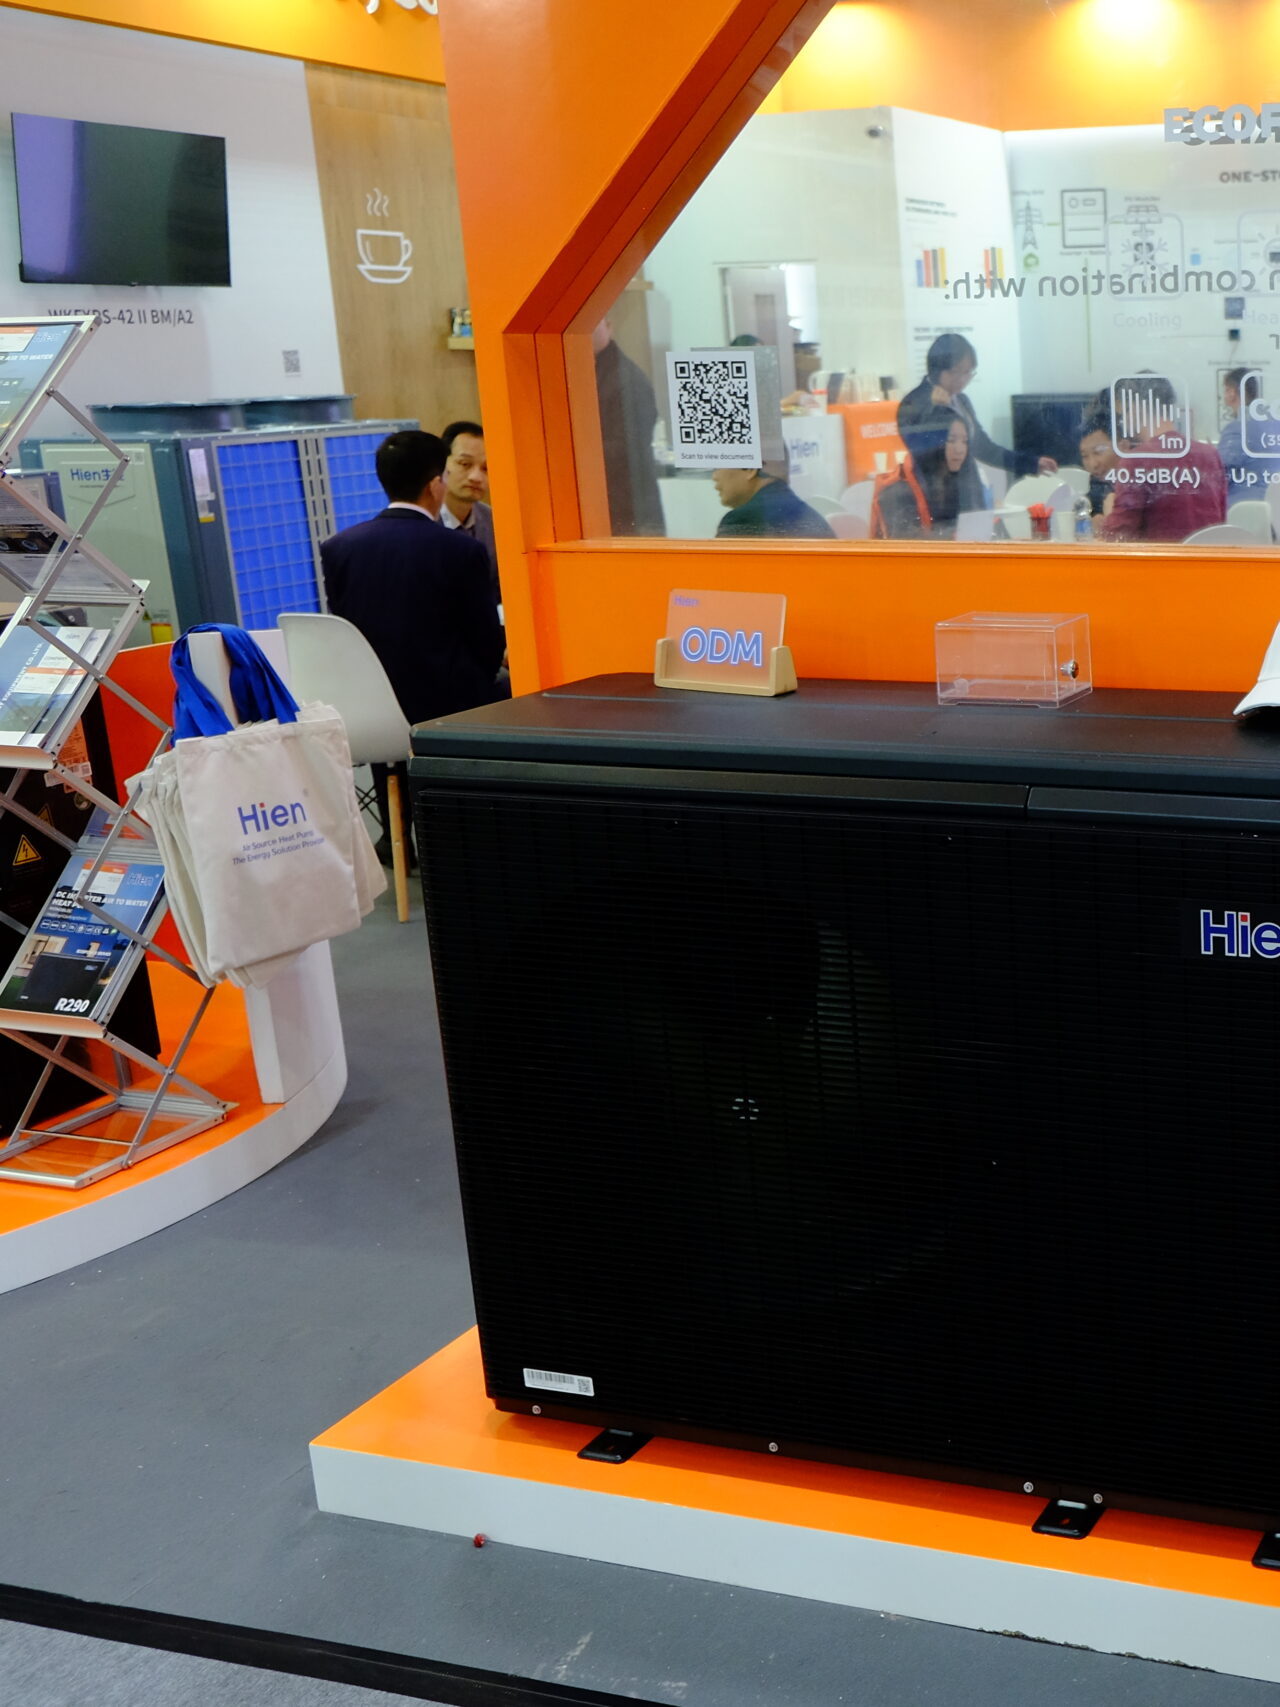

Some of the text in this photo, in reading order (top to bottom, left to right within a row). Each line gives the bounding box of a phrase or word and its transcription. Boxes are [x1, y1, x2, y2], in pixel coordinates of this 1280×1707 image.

[1158, 434, 1184, 449] 1m
[681, 453, 754, 461] Scan to view documents
[1104, 467, 1200, 488] 40.5dB(A)
[1231, 469, 1258, 486] Up
[680, 626, 764, 668] ODM
[237, 802, 307, 836] Hien
[54, 997, 91, 1013] R290
